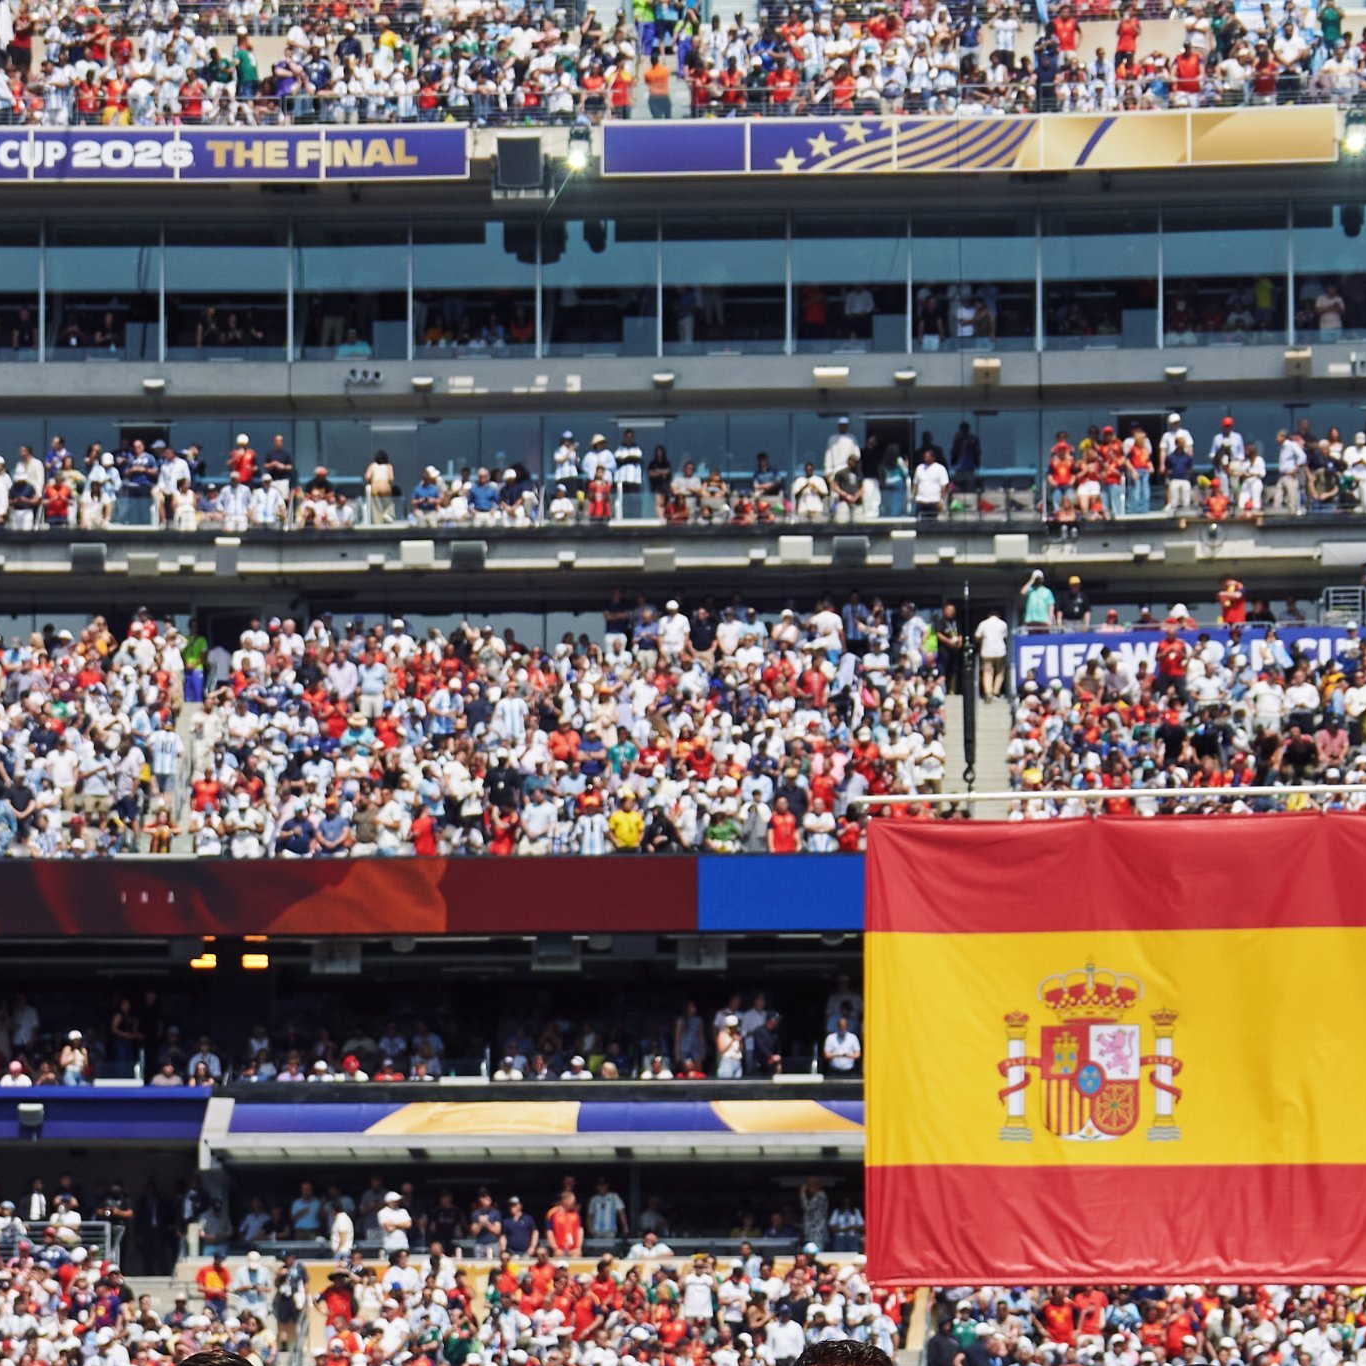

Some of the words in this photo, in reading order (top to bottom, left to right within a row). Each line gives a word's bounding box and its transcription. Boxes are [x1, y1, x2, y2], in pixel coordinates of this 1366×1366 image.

[71, 140, 195, 168] 2026
[206, 139, 289, 168] THE
[296, 137, 418, 168] FINAL
